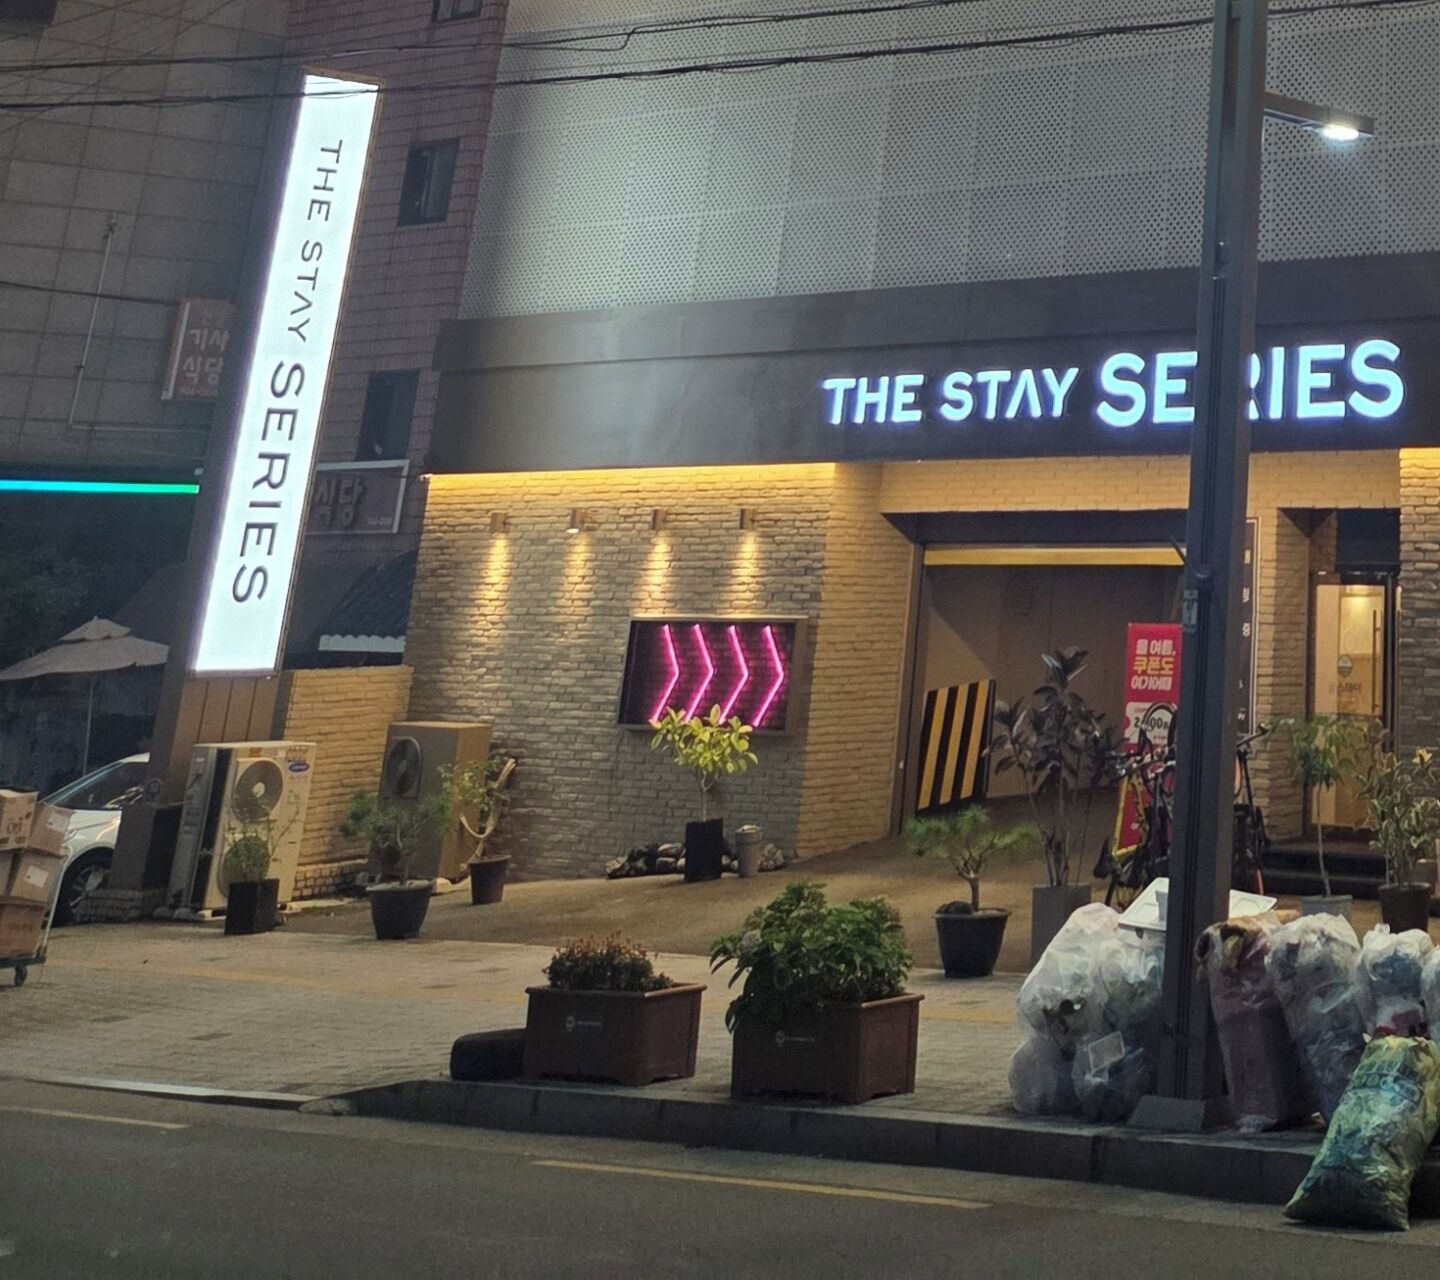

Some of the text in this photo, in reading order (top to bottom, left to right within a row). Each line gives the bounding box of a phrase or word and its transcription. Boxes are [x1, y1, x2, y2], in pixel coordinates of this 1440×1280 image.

[231, 139, 343, 604] THE STAY SERIES
[823, 373, 924, 425] THE
[940, 367, 1079, 422] STAY
[1133, 656, 1175, 675] 쿠폰도
